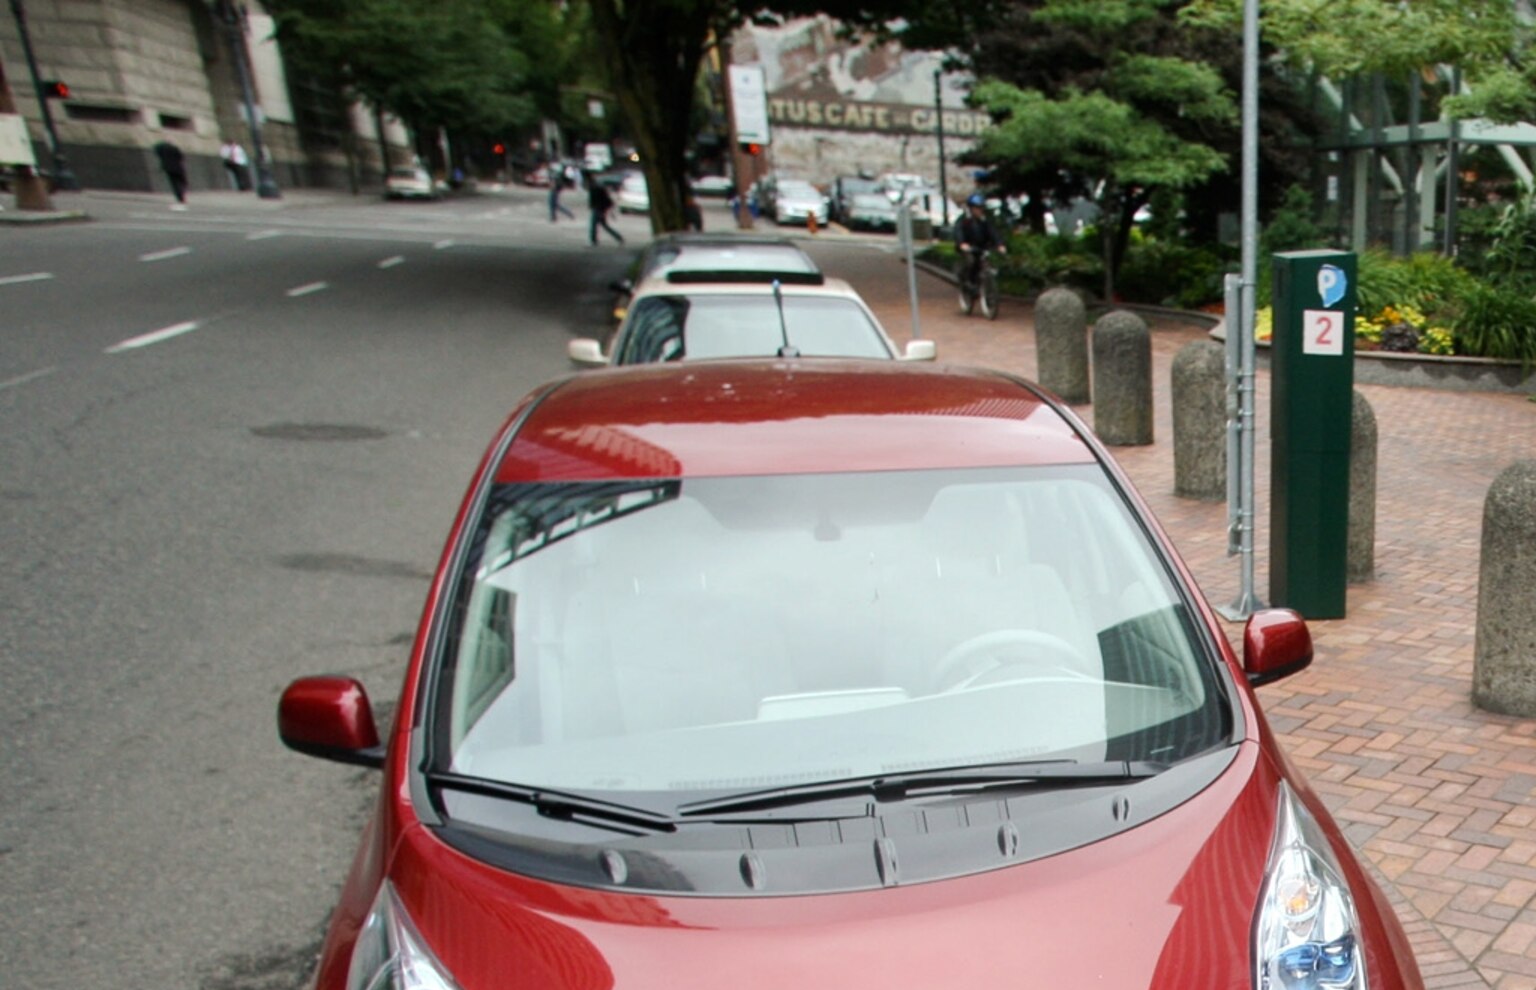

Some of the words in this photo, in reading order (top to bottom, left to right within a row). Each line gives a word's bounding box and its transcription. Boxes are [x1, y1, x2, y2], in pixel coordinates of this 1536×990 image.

[769, 97, 822, 125] TUS
[824, 102, 889, 130] CAFE
[1315, 316, 1333, 345] 2
